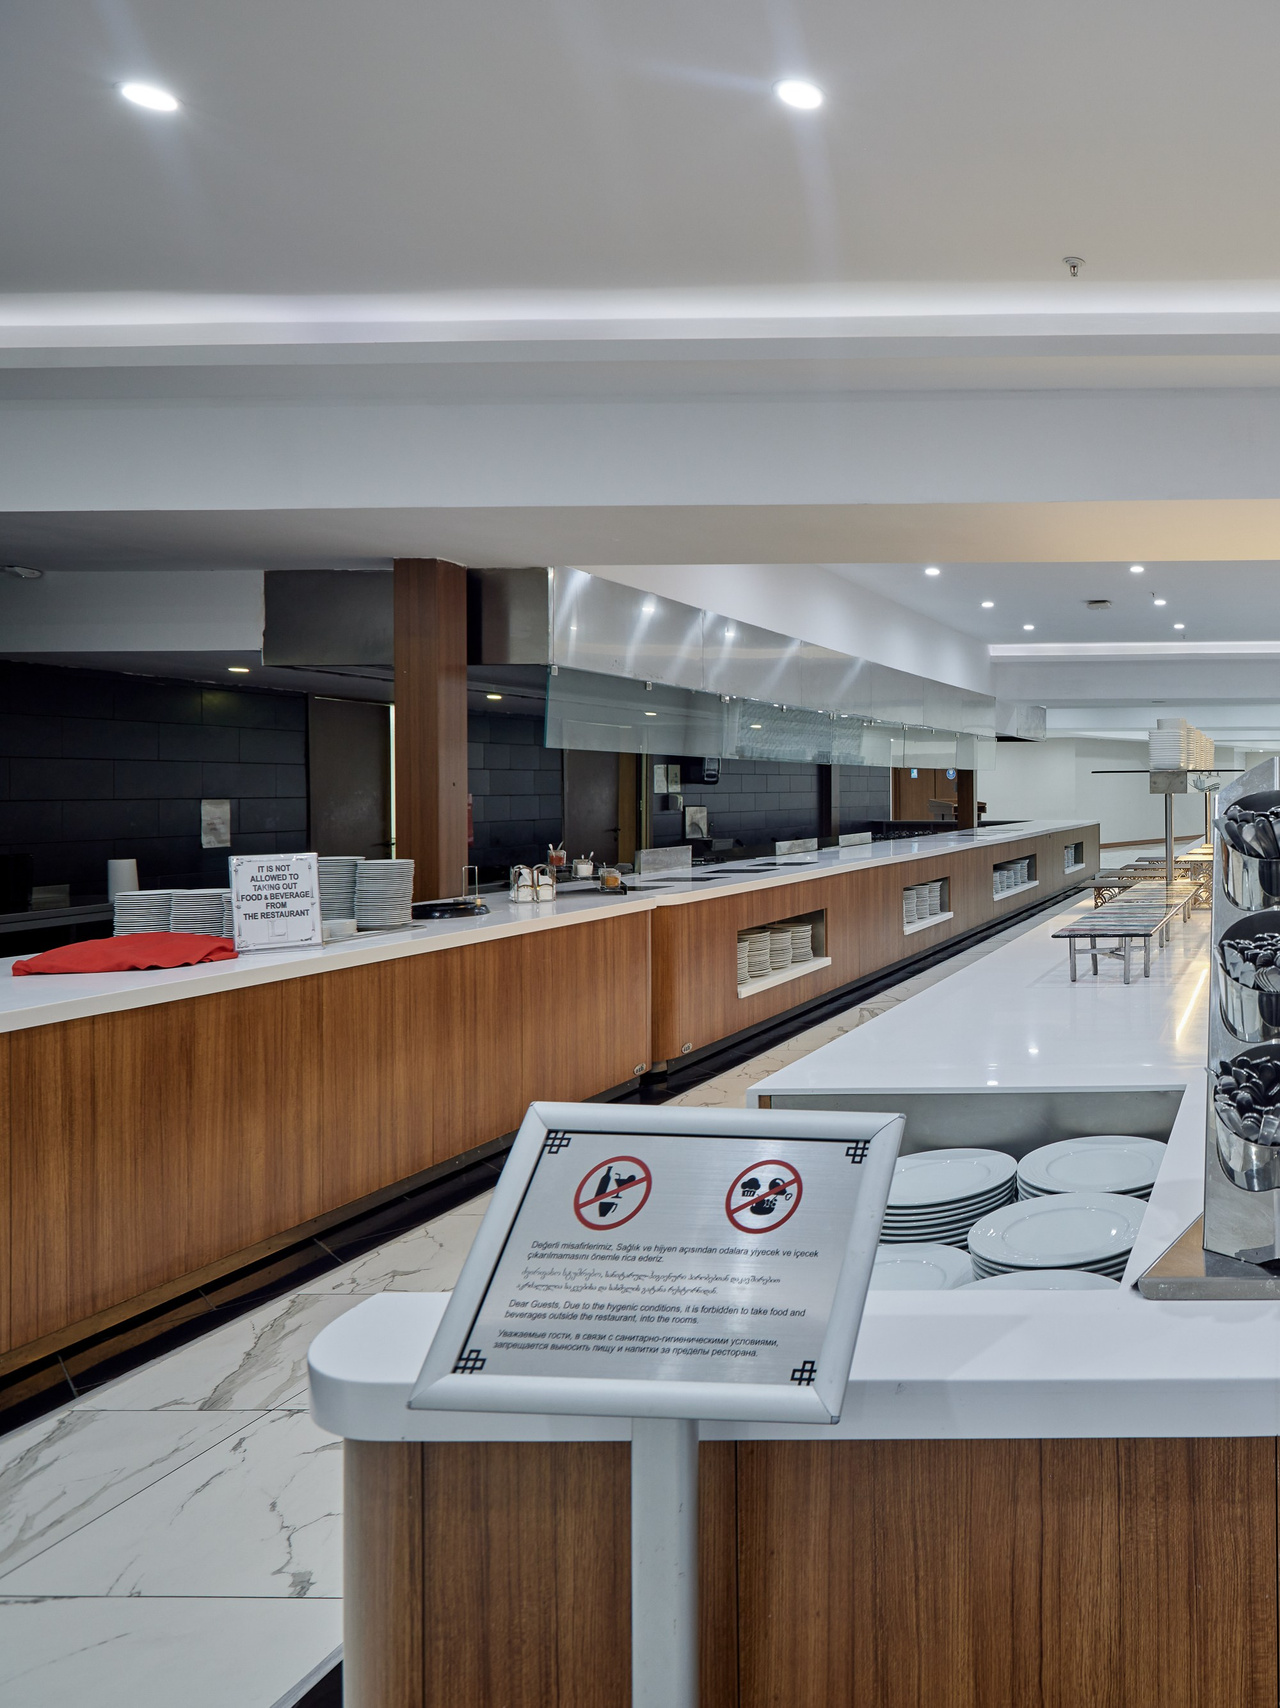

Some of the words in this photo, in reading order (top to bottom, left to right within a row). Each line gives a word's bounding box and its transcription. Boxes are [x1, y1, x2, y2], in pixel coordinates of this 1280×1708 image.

[250, 874, 287, 882] ALLOWED
[241, 894, 263, 902] FOOD
[270, 891, 310, 900] BEVERAGE
[260, 910, 310, 919] RESTAURANT
[531, 1240, 560, 1251] Değerli
[616, 1243, 641, 1253] Sağlık
[653, 1244, 678, 1254] hijyen
[678, 1246, 718, 1255] açısından
[718, 1247, 749, 1255] odalara
[749, 1248, 781, 1257] yiyecek
[793, 1249, 819, 1259] içecek
[590, 1253, 620, 1261] önemle
[621, 1254, 637, 1262] rica
[637, 1254, 664, 1263] ederiz.
[508, 1299, 530, 1308] Dear
[563, 1300, 581, 1310] Due
[581, 1302, 591, 1310] to
[591, 1302, 605, 1311] the
[606, 1302, 639, 1313] hygenic
[684, 1305, 691, 1313] it
[691, 1305, 699, 1313] is
[700, 1304, 739, 1315] forbidden
[740, 1306, 749, 1315] to
[750, 1307, 769, 1316] take
[769, 1307, 789, 1317] food
[789, 1309, 807, 1317] and
[504, 1310, 547, 1321] beverages
[548, 1312, 579, 1321] outside
[579, 1312, 594, 1321] the
[639, 1314, 656, 1323] into
[656, 1315, 670, 1323] the
[671, 1316, 699, 1324] rooms.
[497, 1329, 547, 1339] Уважаемые
[582, 1333, 607, 1341] связи
[614, 1334, 729, 1345] санитарно-гигиеническими
[729, 1338, 779, 1348] условиями,
[492, 1342, 549, 1350] запрещается
[549, 1343, 591, 1352] выносить
[592, 1345, 616, 1354] пищу
[624, 1346, 660, 1354] напитки
[672, 1347, 710, 1356] пределы
[710, 1349, 758, 1358] ресторана.
